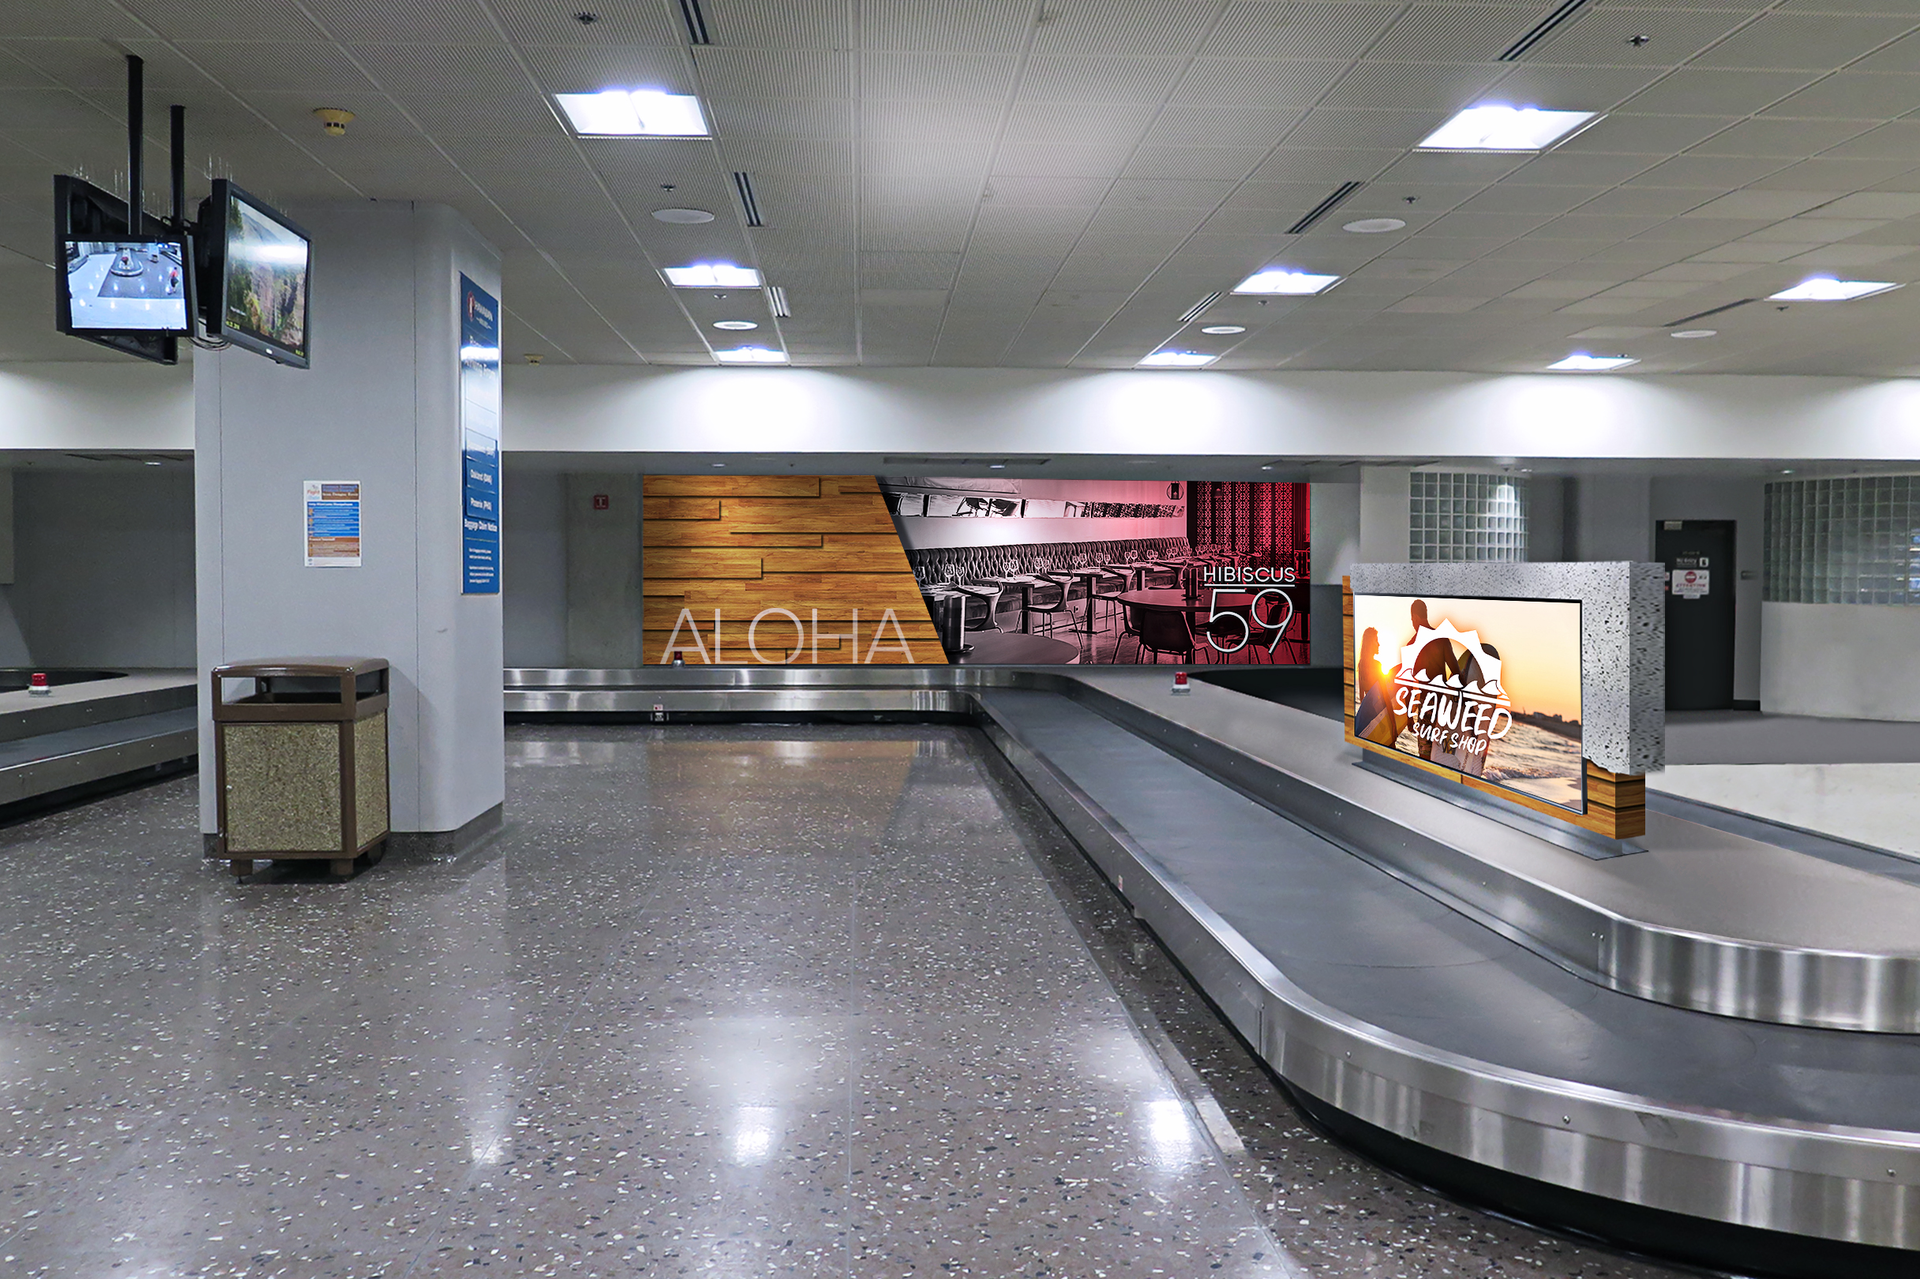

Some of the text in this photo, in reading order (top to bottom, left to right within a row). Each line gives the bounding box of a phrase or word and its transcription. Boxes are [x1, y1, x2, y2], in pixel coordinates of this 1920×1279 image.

[1203, 566, 1296, 583] HIBISCUS
[659, 607, 915, 665] ALOHA
[1206, 588, 1293, 654] 59
[1393, 686, 1513, 740] SEAWEED
[1412, 721, 1487, 756] SURF SHOP
